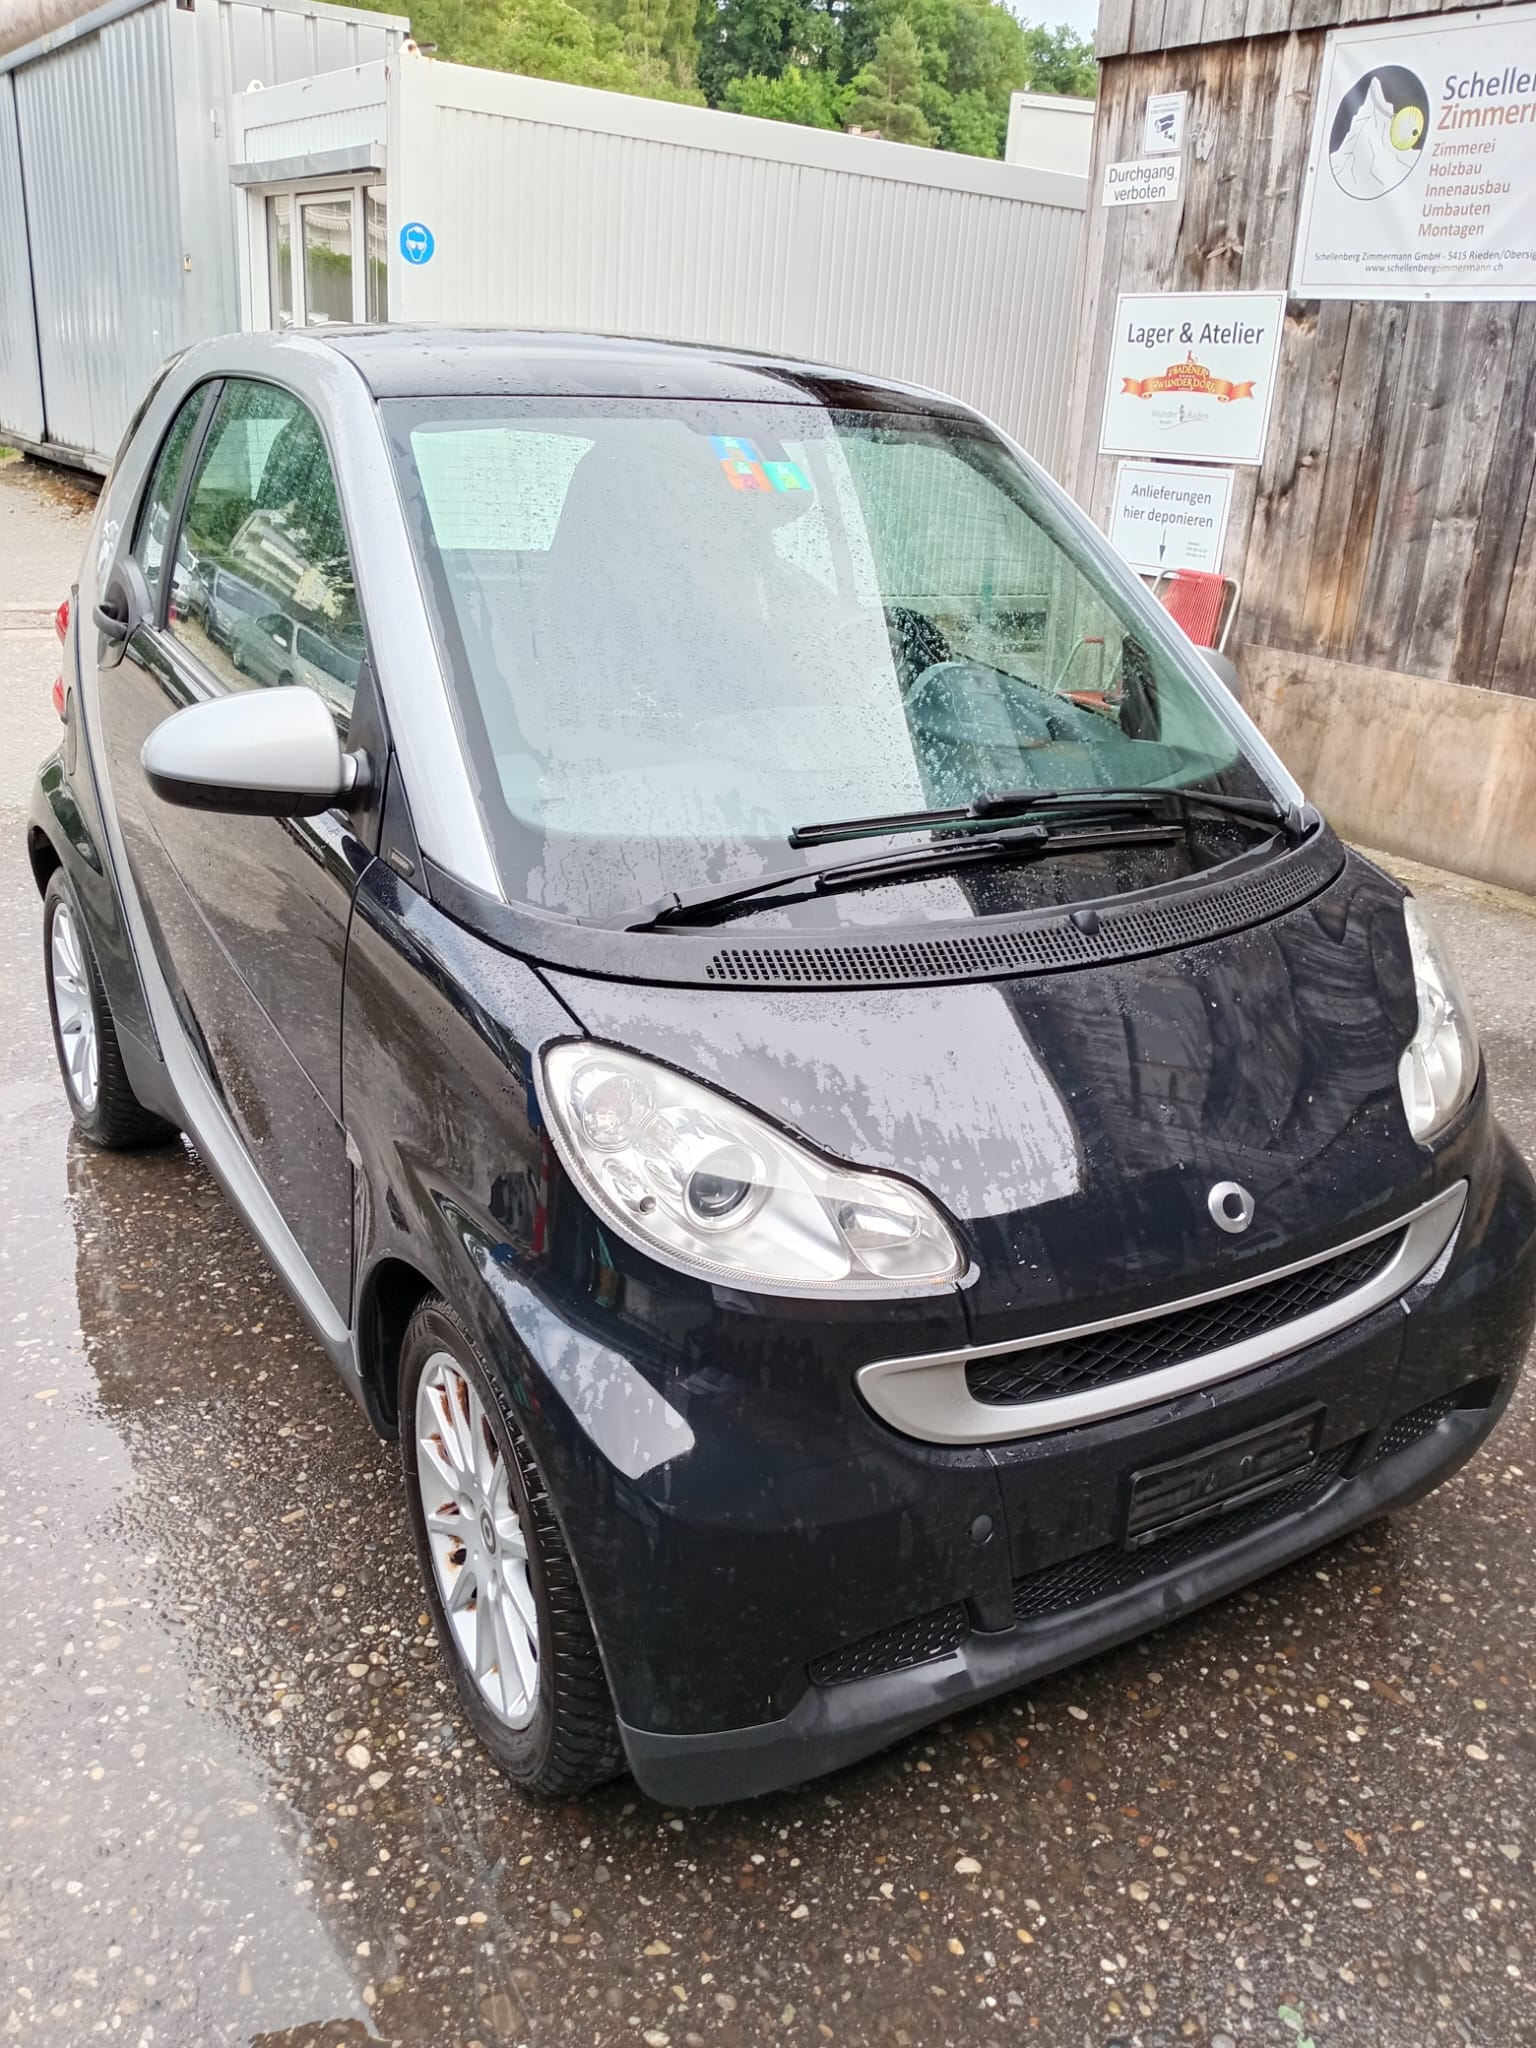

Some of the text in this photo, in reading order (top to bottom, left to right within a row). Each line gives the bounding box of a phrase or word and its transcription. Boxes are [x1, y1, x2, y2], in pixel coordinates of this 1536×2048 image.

[1437, 101, 1536, 130] Zimmer
[1432, 138, 1496, 157] Zimmerei
[1109, 166, 1175, 183] Durchgang
[1429, 162, 1482, 177] Holzbau
[1114, 184, 1166, 201] verboten
[1425, 180, 1511, 197] Innenausbau
[1422, 202, 1491, 217] Umbauten
[1418, 222, 1484, 239] Montagen
[1315, 252, 1360, 263] Schellenberg
[1361, 251, 1412, 262] Zimmermann
[1414, 252, 1441, 261] GmbH
[1448, 251, 1467, 260] 5415
[1365, 263, 1503, 274] www.schellenbergzimmermann.ch
[1128, 322, 1264, 348] Lager & Atelier
[1130, 484, 1211, 506] Anlieferungen
[1123, 505, 1213, 528] hier deponieren
